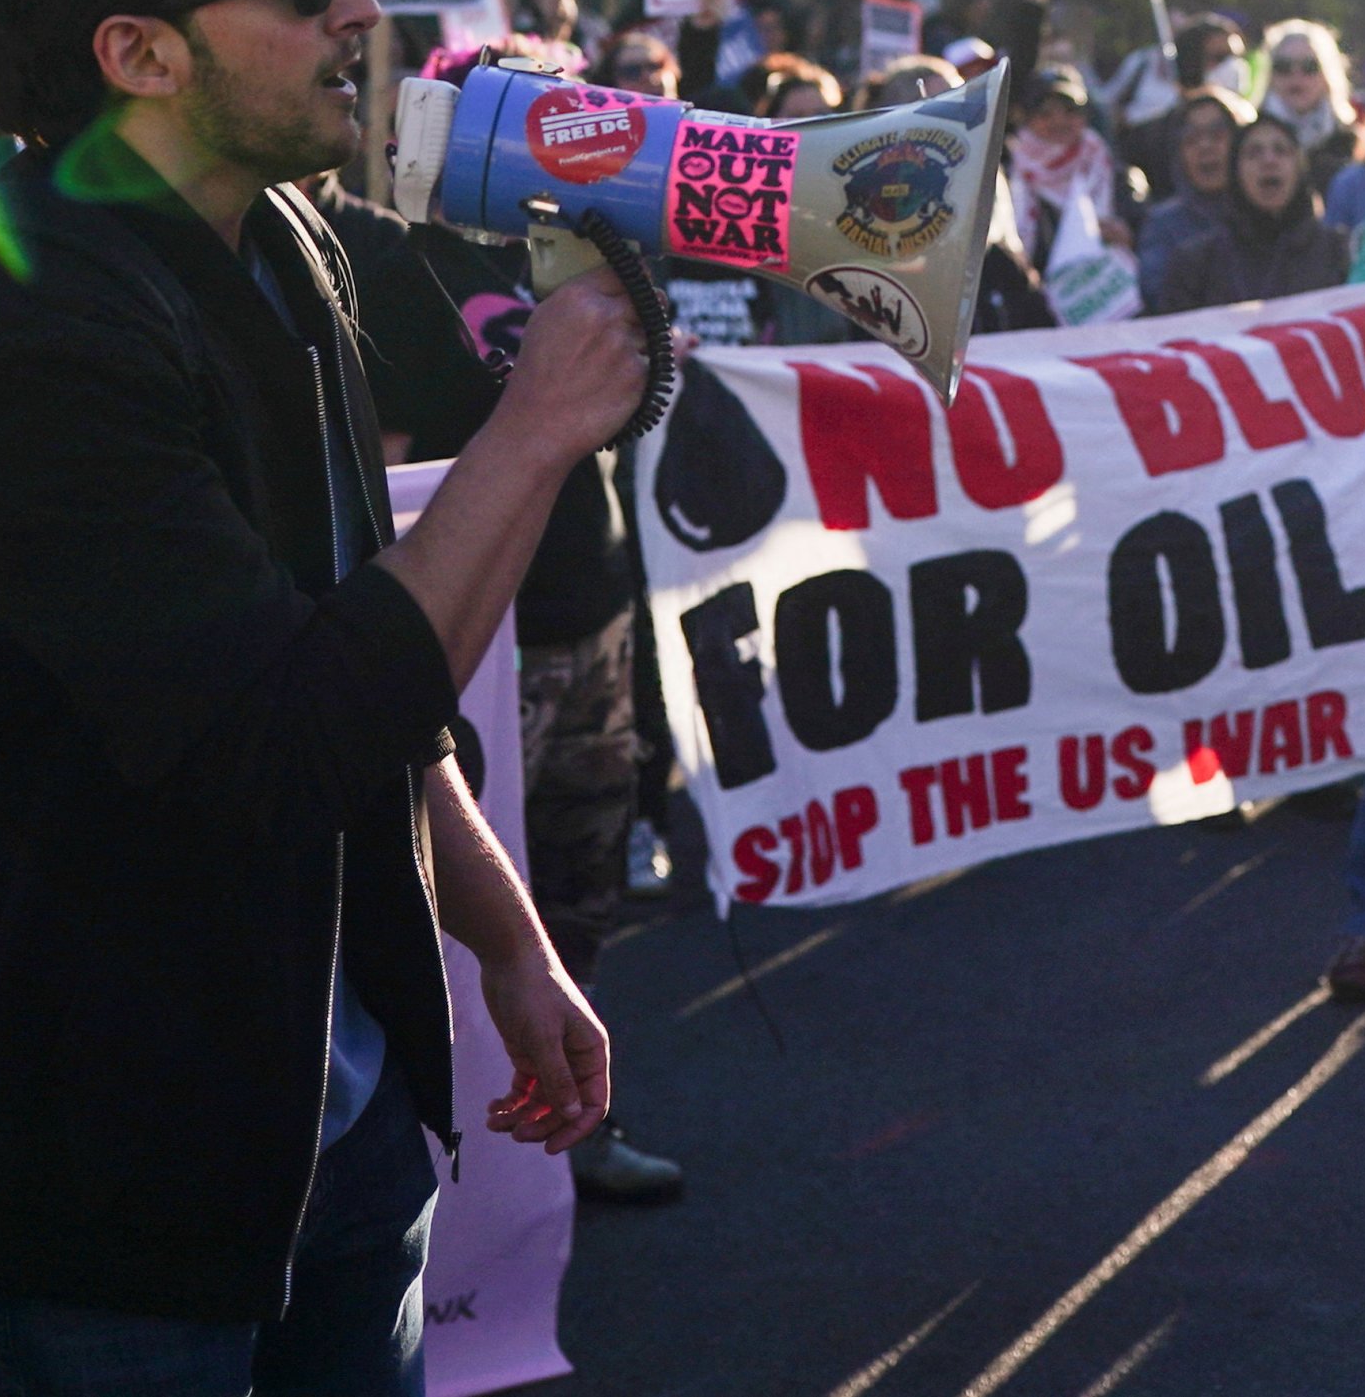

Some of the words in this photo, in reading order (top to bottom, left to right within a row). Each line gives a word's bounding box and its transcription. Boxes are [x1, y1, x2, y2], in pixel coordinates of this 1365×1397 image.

[542, 122, 598, 148] FREE
[600, 118, 632, 135] DC
[682, 126, 796, 157] MAKE
[834, 130, 899, 171] CLIMATE
[678, 150, 792, 188] OUT
[675, 182, 788, 225] NOT
[674, 216, 784, 255] WAR
[838, 216, 892, 255] RACIAL
[896, 207, 954, 257] JUSTICE
[791, 362, 1065, 531] NO
[679, 549, 1031, 790] FOR
[732, 784, 877, 905] STOP
[899, 746, 1030, 847] THE
[1056, 724, 1157, 811] US
[1182, 690, 1353, 786] WAR
